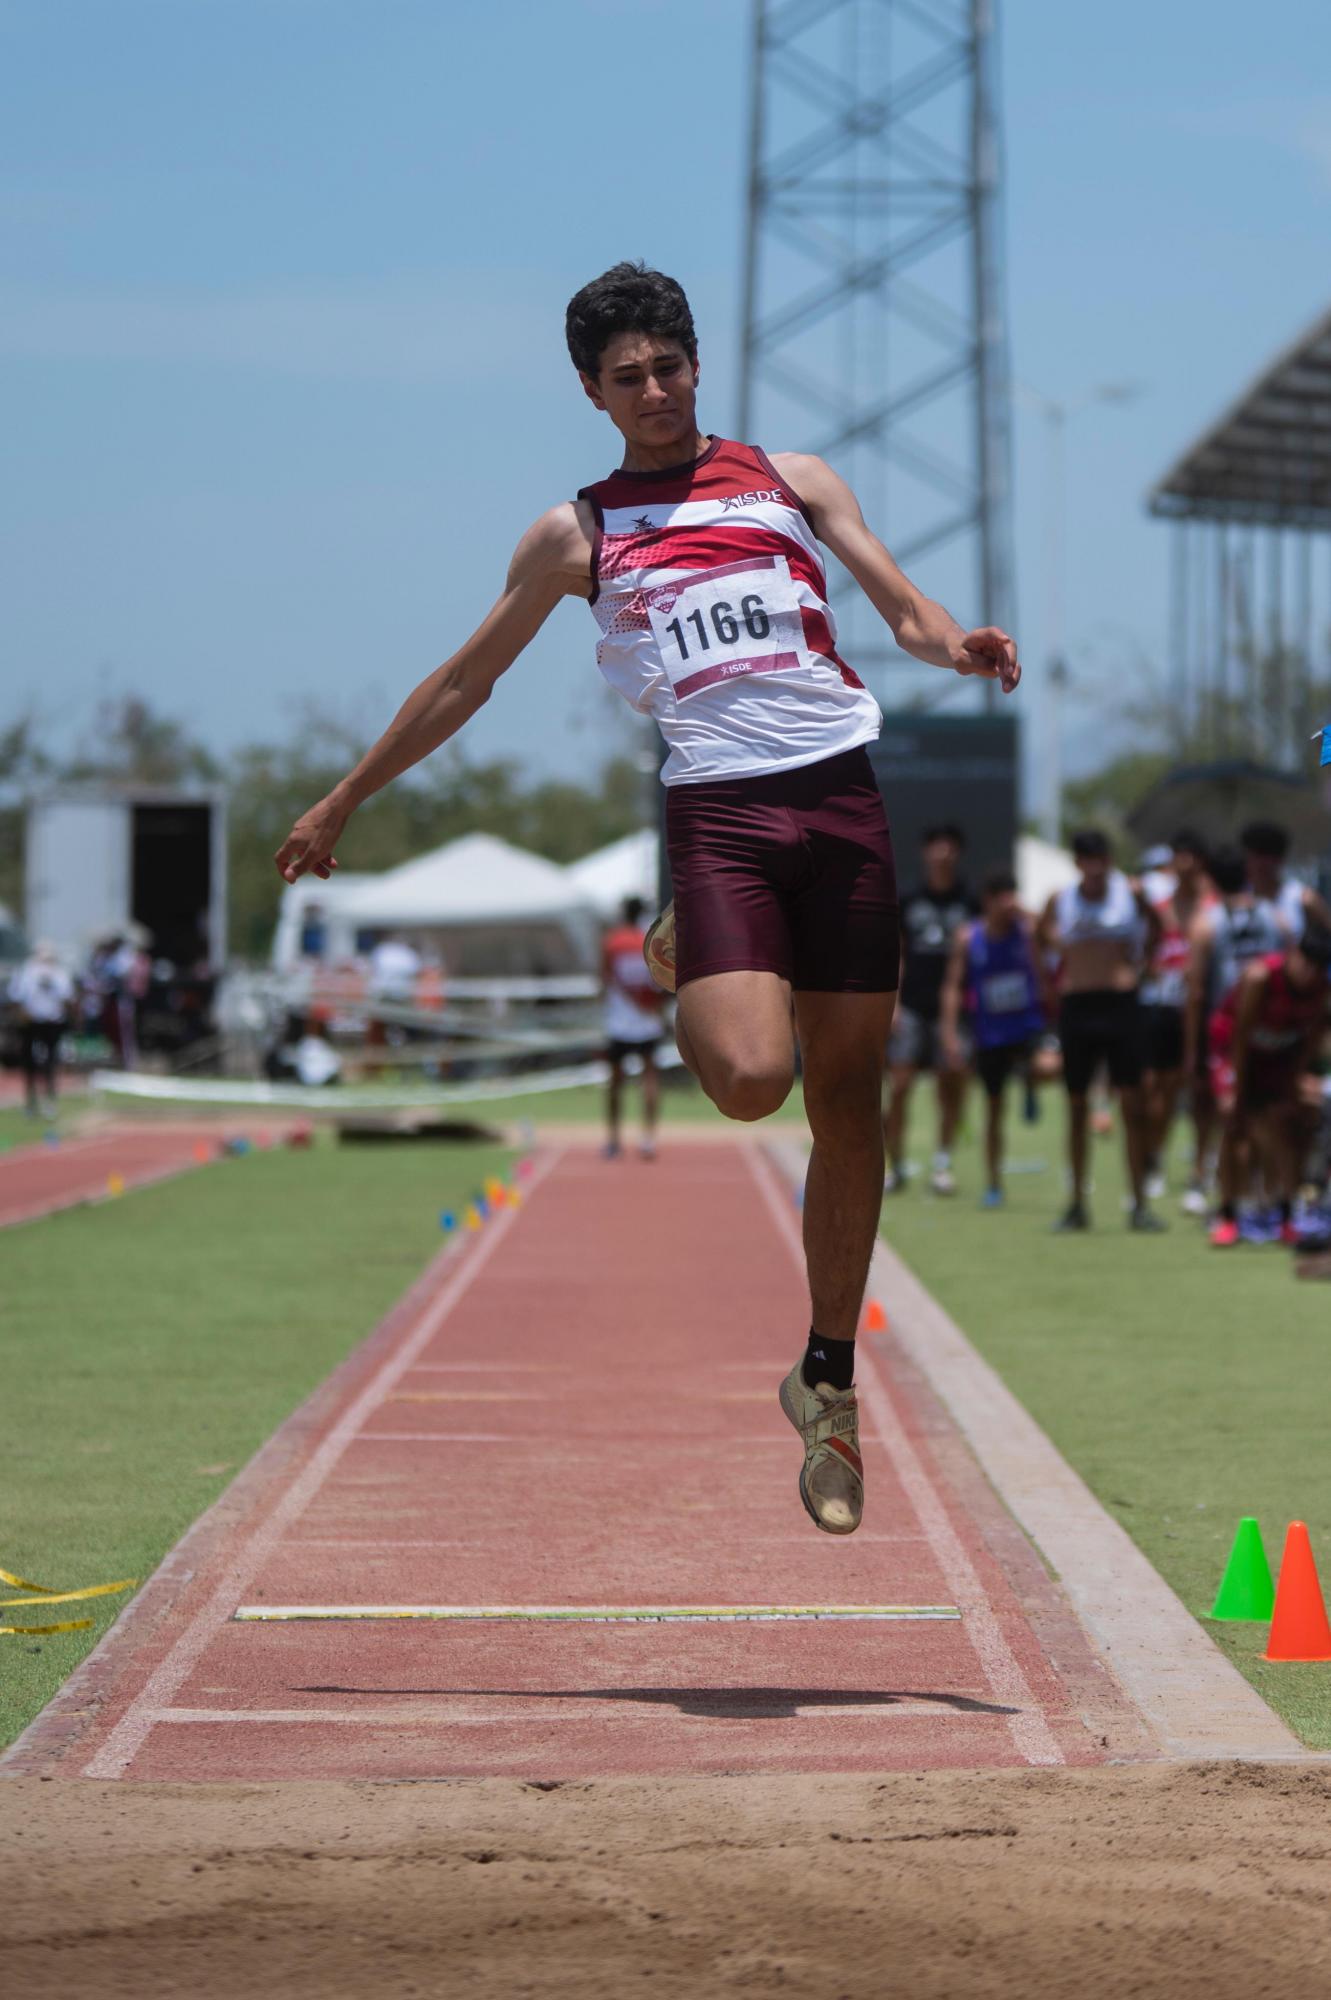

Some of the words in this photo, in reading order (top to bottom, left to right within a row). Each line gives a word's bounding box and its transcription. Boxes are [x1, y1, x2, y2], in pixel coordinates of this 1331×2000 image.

[737, 489, 783, 506] ISDE
[665, 594, 770, 660] 1166
[728, 662, 752, 674] ISDE
